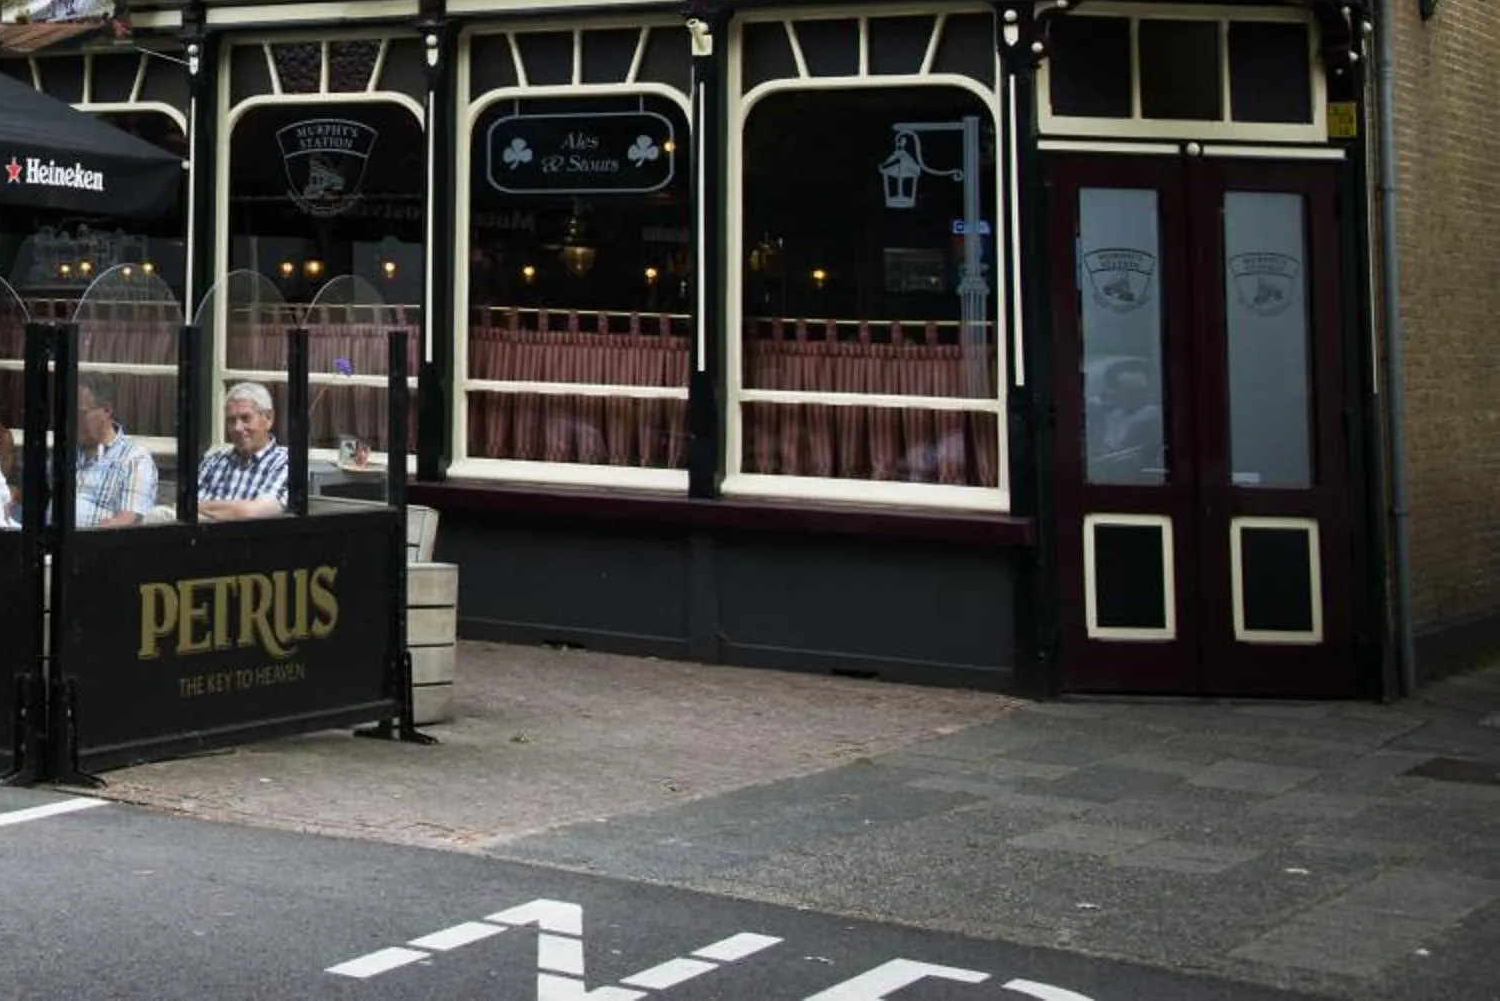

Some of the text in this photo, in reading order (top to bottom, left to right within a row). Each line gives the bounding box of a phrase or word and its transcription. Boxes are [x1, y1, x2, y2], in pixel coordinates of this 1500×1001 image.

[560, 132, 599, 150] Ales
[26, 157, 104, 191] Heineken
[138, 565, 339, 661] PETRUS
[179, 661, 307, 697] THE KEY TO HEAVEN
